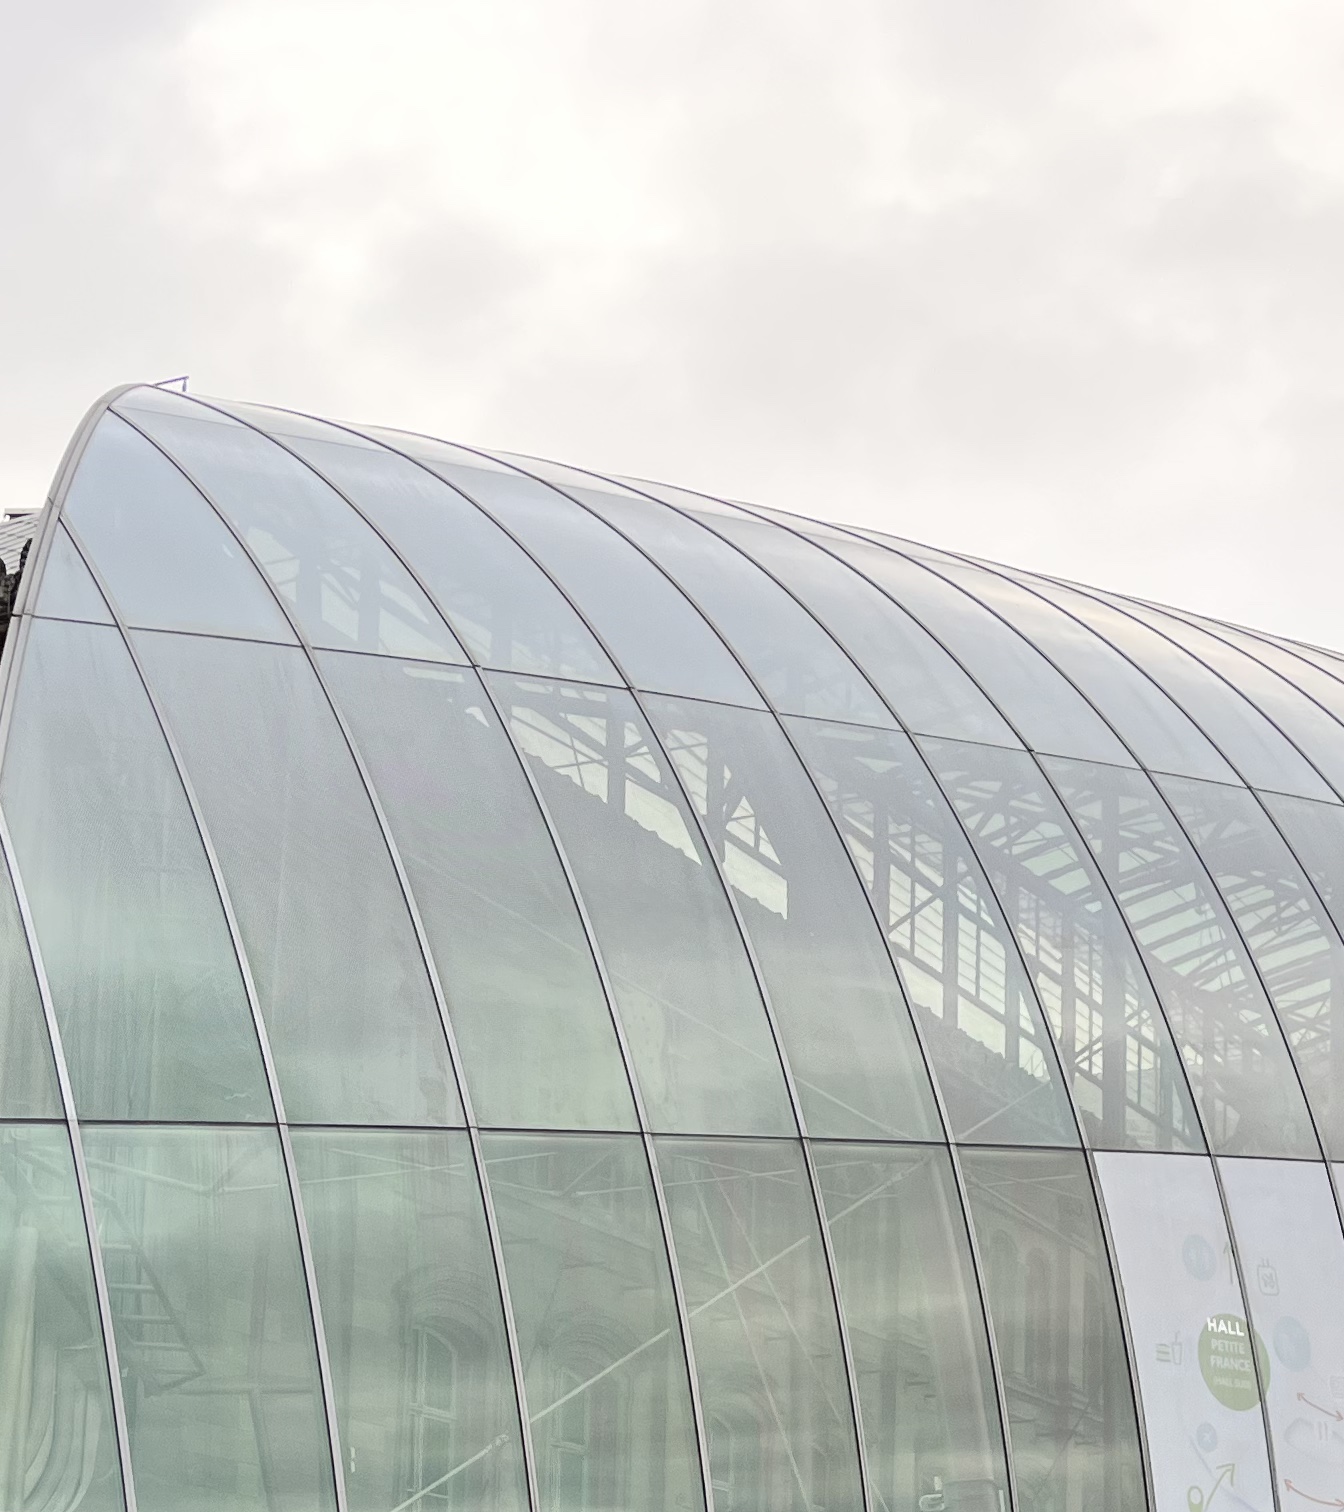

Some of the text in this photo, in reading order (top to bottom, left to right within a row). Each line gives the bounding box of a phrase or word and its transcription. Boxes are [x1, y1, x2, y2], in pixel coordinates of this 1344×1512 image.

[1206, 1317, 1245, 1337] HALL
[1210, 1338, 1246, 1355] PETITE
[1209, 1355, 1252, 1373] FRANCE
